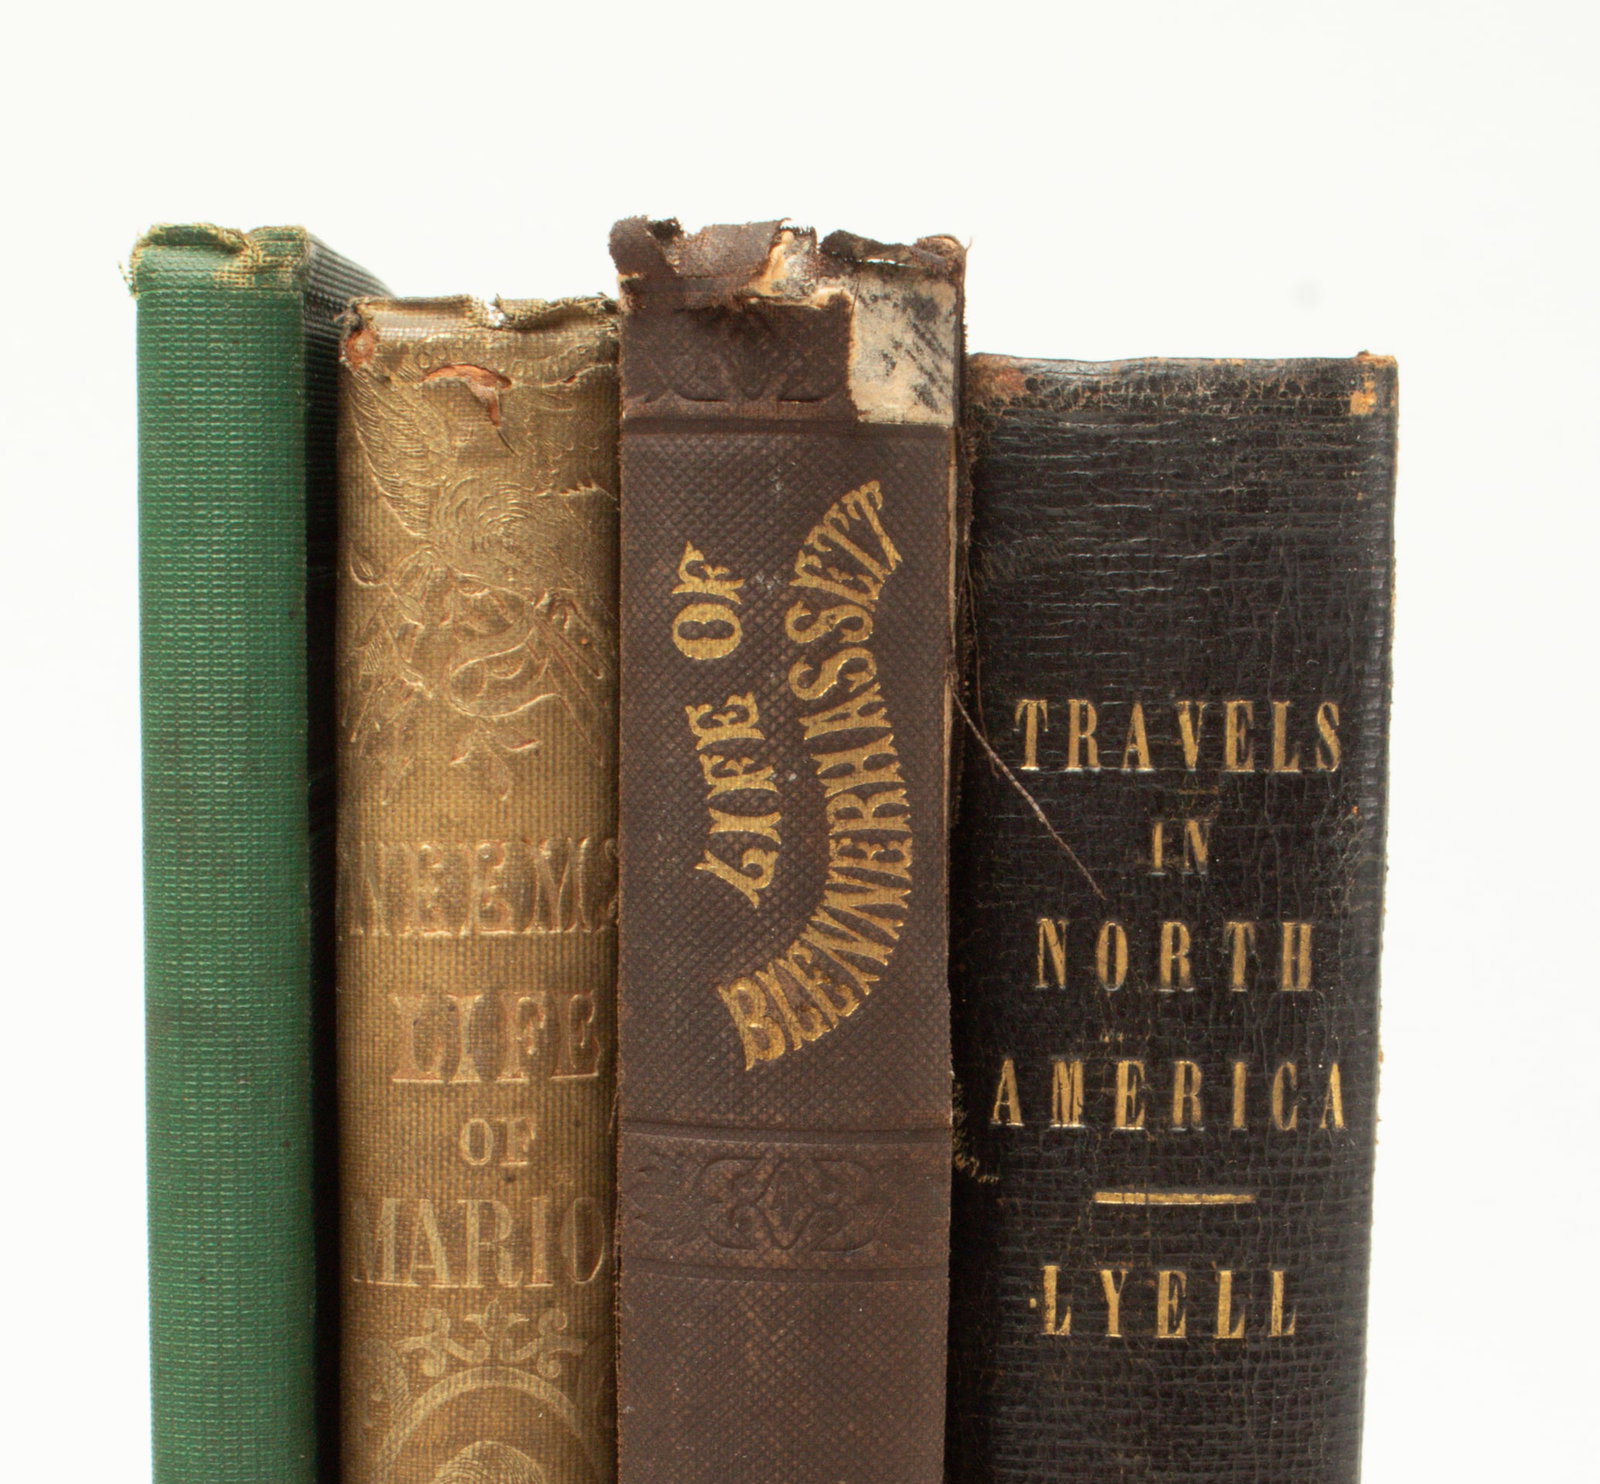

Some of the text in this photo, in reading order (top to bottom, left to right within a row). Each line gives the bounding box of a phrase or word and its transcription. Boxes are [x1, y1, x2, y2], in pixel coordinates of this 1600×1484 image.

[671, 541, 782, 908] LIFE OF
[1015, 698, 1342, 773] TRAVELS
[716, 480, 914, 1071] BLENNERHASSETT
[1152, 819, 1209, 876] IN
[1035, 917, 1313, 993] NORTH
[391, 992, 599, 1083] LIFE
[991, 1058, 1348, 1132] AMERICA
[459, 1117, 537, 1168] OF
[1040, 1264, 1297, 1340] LYELL
